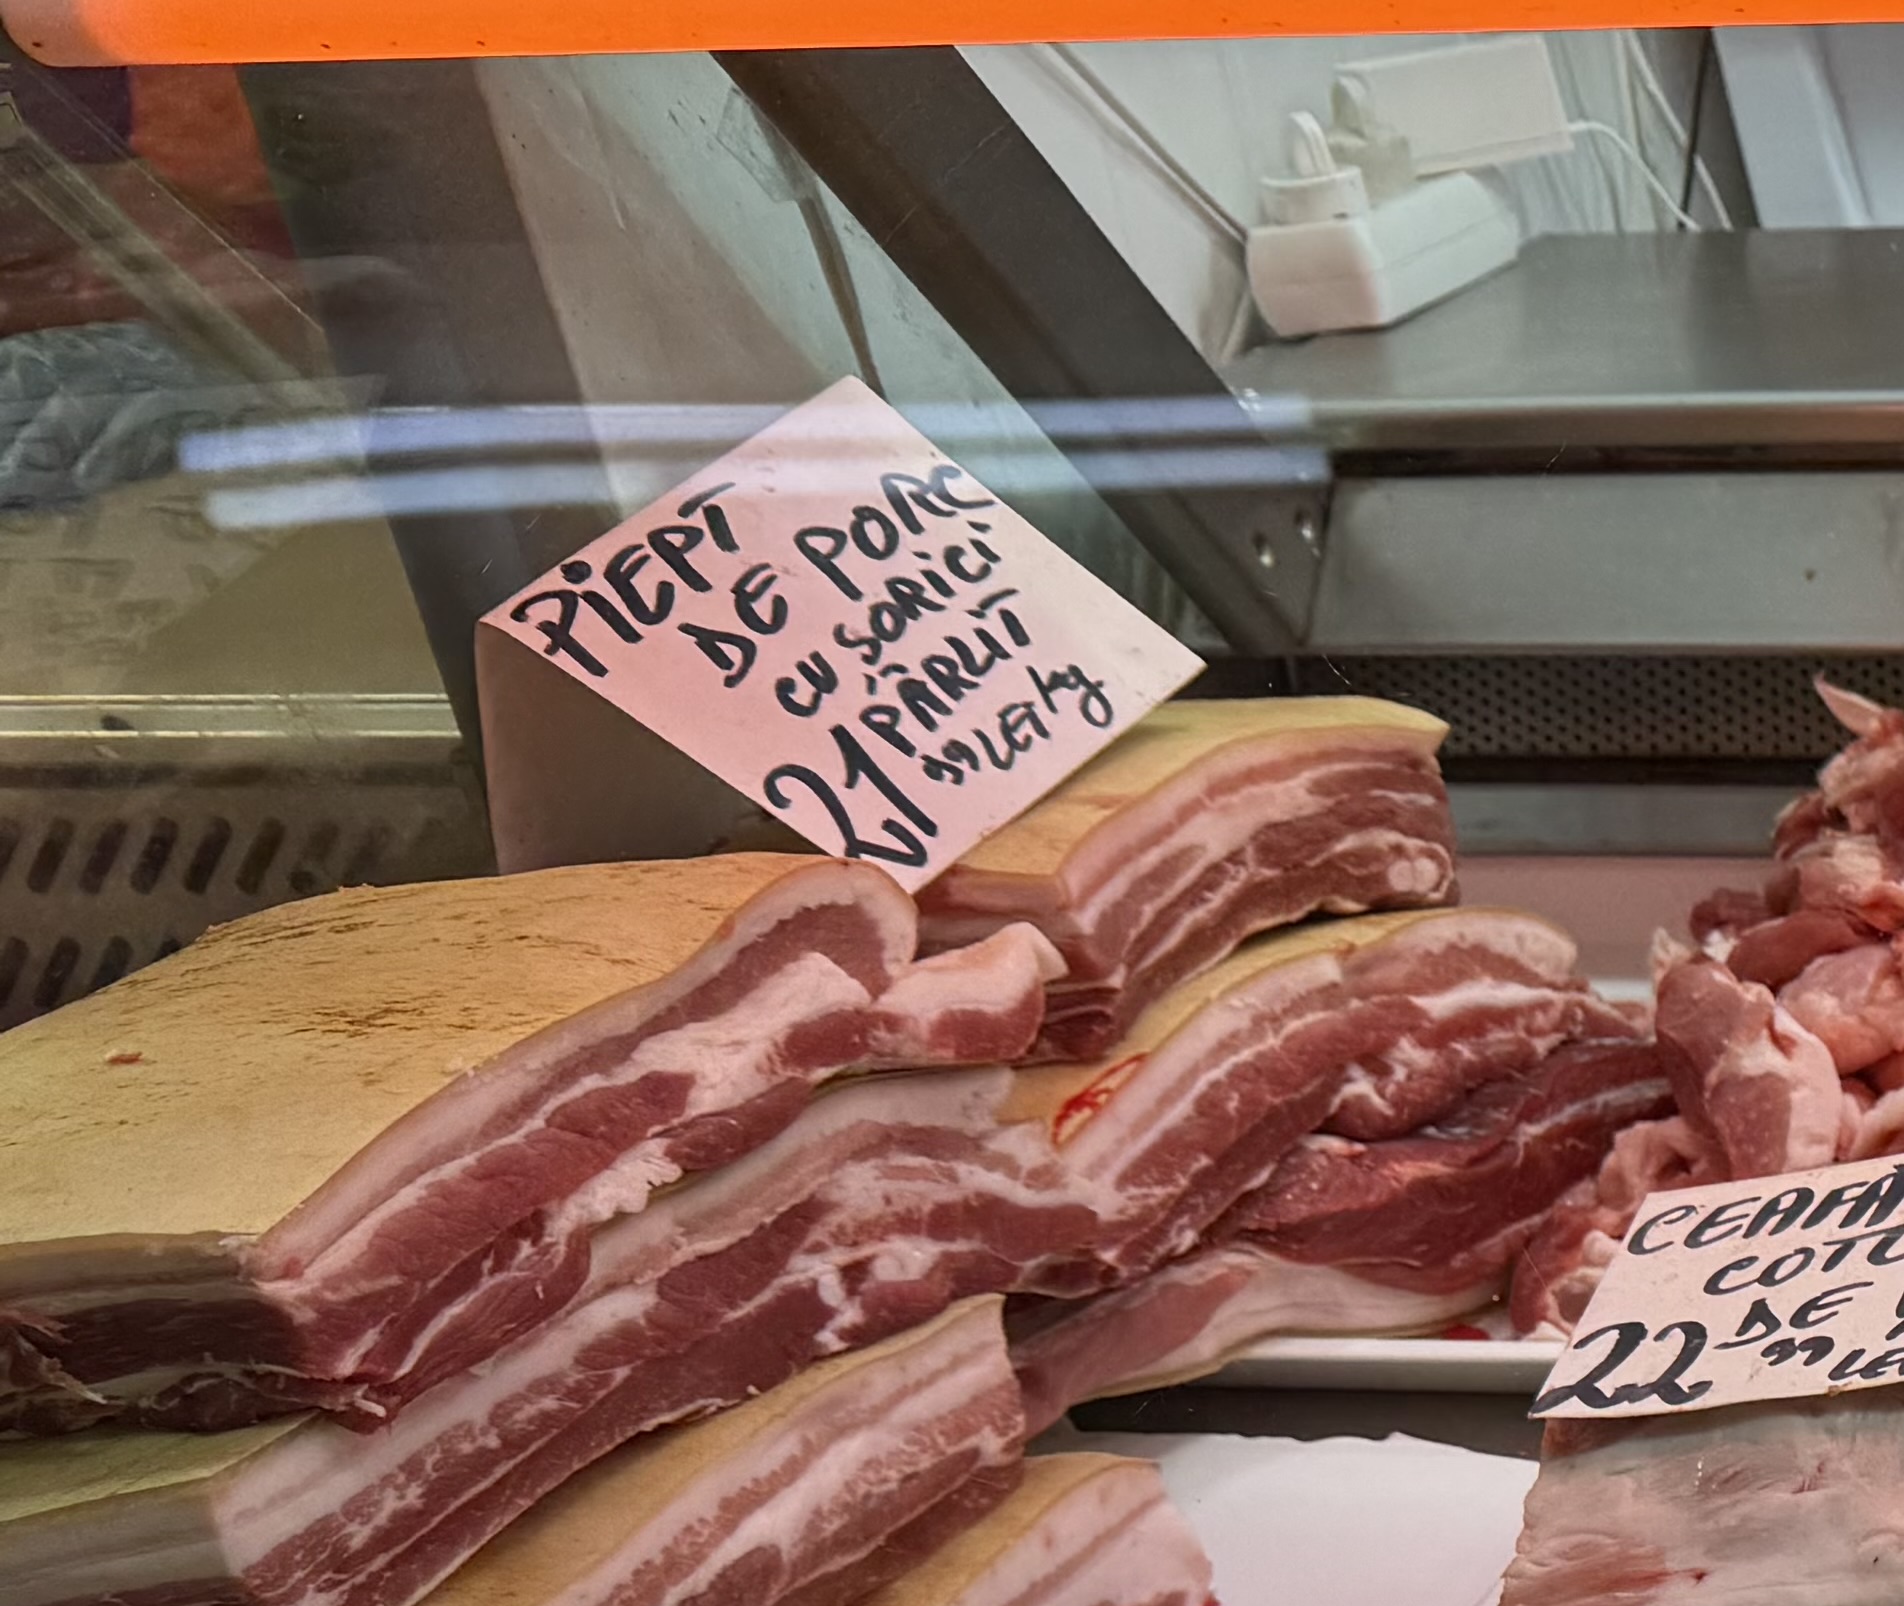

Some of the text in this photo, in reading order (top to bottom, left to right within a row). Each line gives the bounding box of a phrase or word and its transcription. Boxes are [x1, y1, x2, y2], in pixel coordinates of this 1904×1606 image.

[676, 464, 997, 689] DE PORC
[775, 650, 840, 717] CU
[763, 724, 940, 868] 21
[920, 738, 981, 786] 99
[973, 701, 1051, 771] LEI
[1713, 1281, 1874, 1350] DE
[1528, 1320, 1714, 1415] 22
